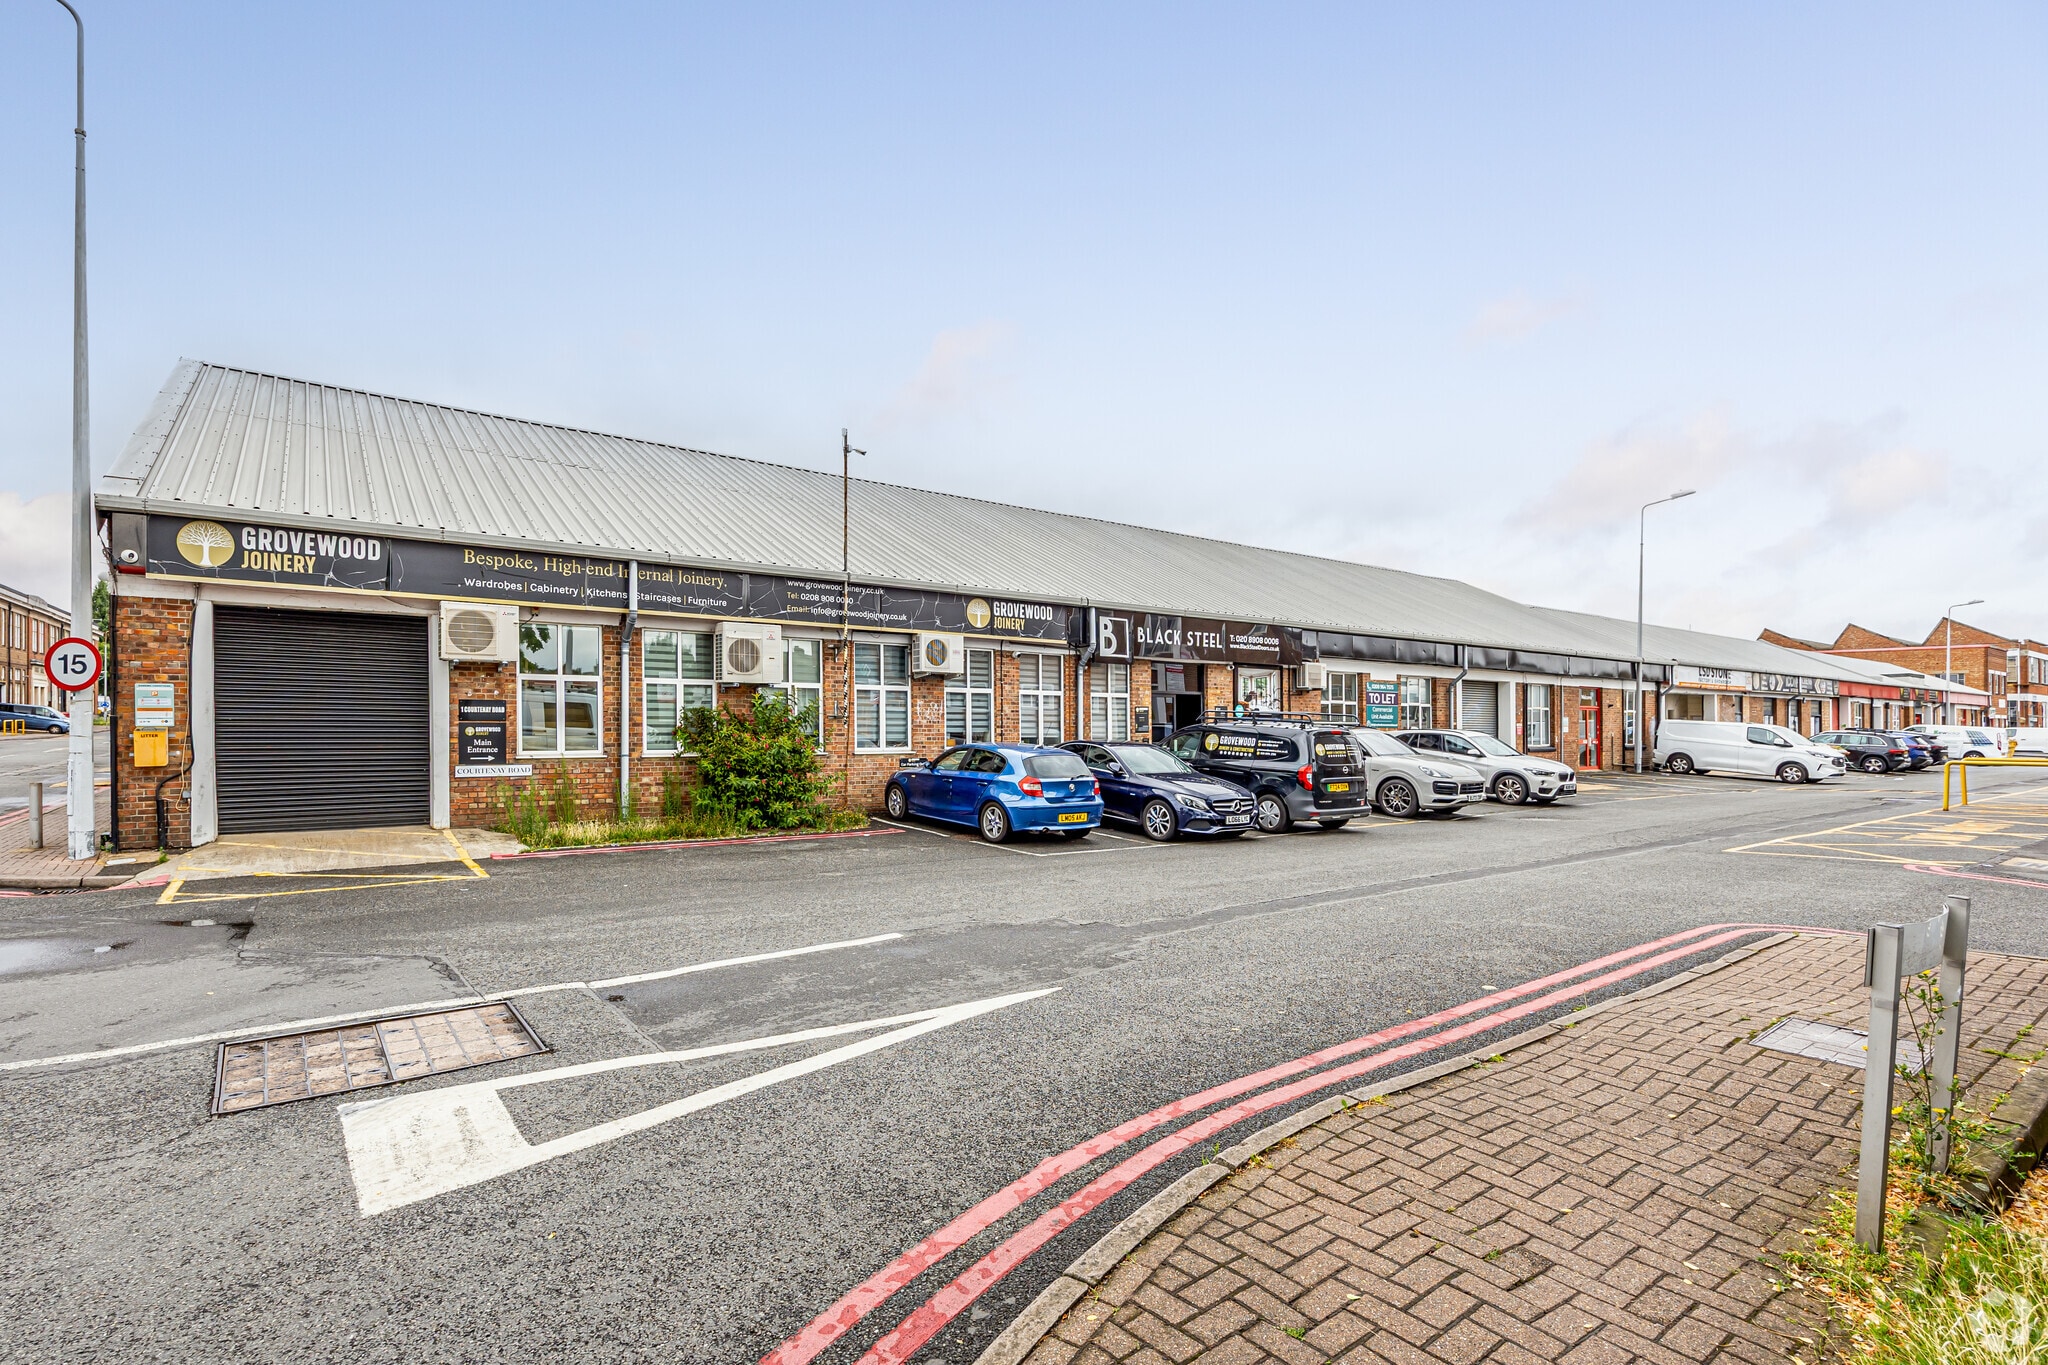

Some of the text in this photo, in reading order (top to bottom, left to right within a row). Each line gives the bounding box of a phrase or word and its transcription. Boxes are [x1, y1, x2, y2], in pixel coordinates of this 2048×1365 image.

[241, 526, 381, 561] GROVEWOOD
[241, 550, 316, 574] JOINERY
[463, 549, 728, 590] Bespoke, High-end Iernal Joinery.
[464, 577, 727, 607] Wardrobes Cabinetry Kitchens Staircases Furniture
[787, 591, 854, 605] Tel: 0208 908 000
[786, 604, 809, 613] Email:
[993, 601, 1053, 621] GROVEWOOD
[993, 616, 1025, 630] JOINERY
[1137, 626, 1223, 649] BLACK STEEL
[1236, 635, 1248, 643] 020
[57, 653, 88, 675] 15
[1711, 667, 1731, 680] STONE
[1368, 692, 1396, 704] TO LET
[1219, 735, 1257, 747] GROVEWOOD
[456, 766, 531, 775] COURTENAY ROAD
[1060, 813, 1086, 822] LM05 AKJ
